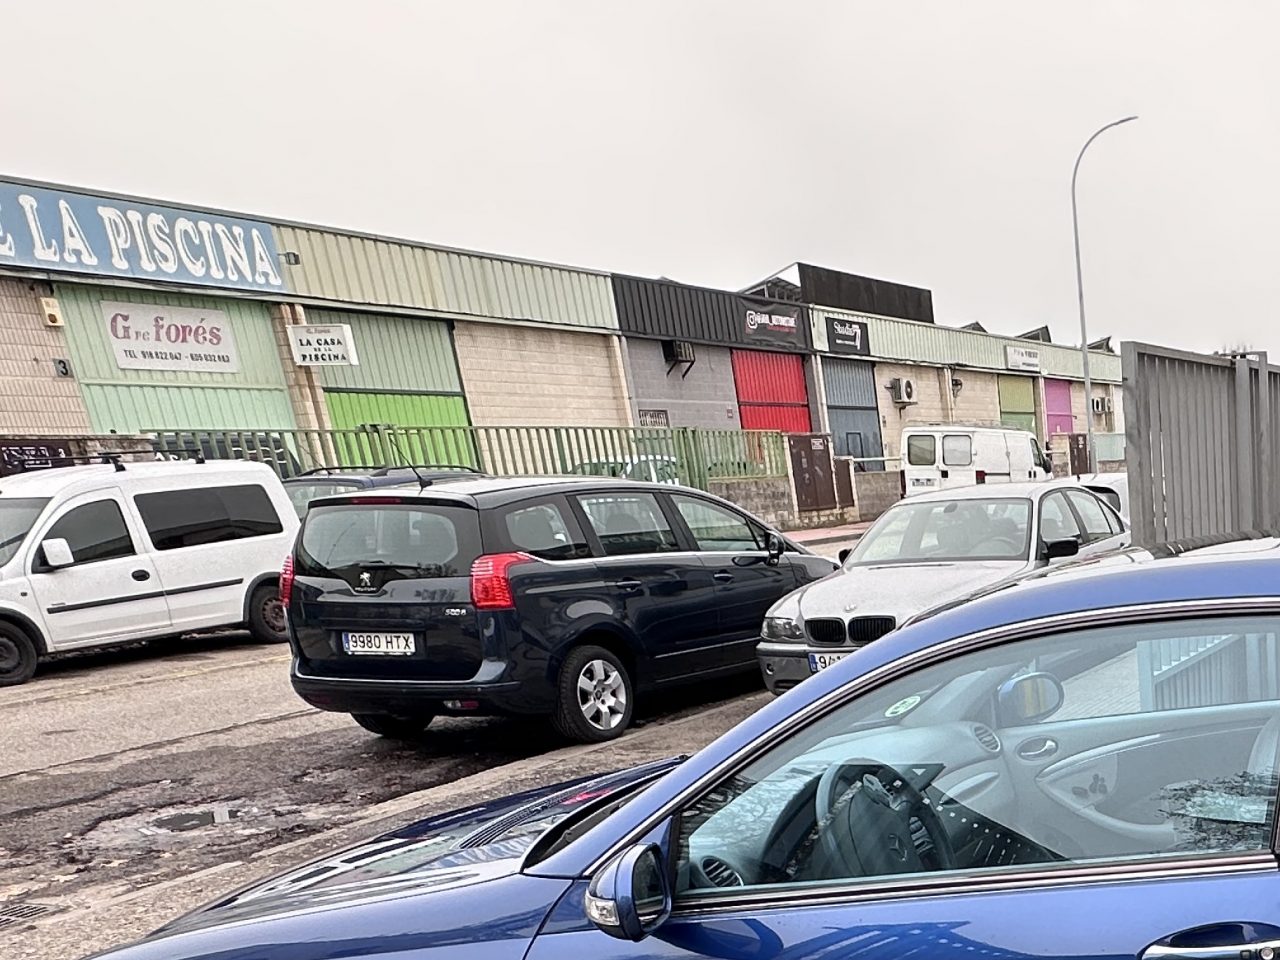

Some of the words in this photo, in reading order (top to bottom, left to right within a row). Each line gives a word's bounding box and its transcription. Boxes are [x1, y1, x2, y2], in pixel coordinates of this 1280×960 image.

[18, 194, 98, 265] LA
[97, 206, 281, 285] PISCINA
[153, 315, 222, 346] forés
[316, 338, 343, 346] CASA
[124, 349, 138, 359] TEL
[301, 353, 347, 362] PISCINA
[58, 360, 69, 375] 3
[350, 634, 381, 649] 9980
[385, 635, 411, 650] HTX
